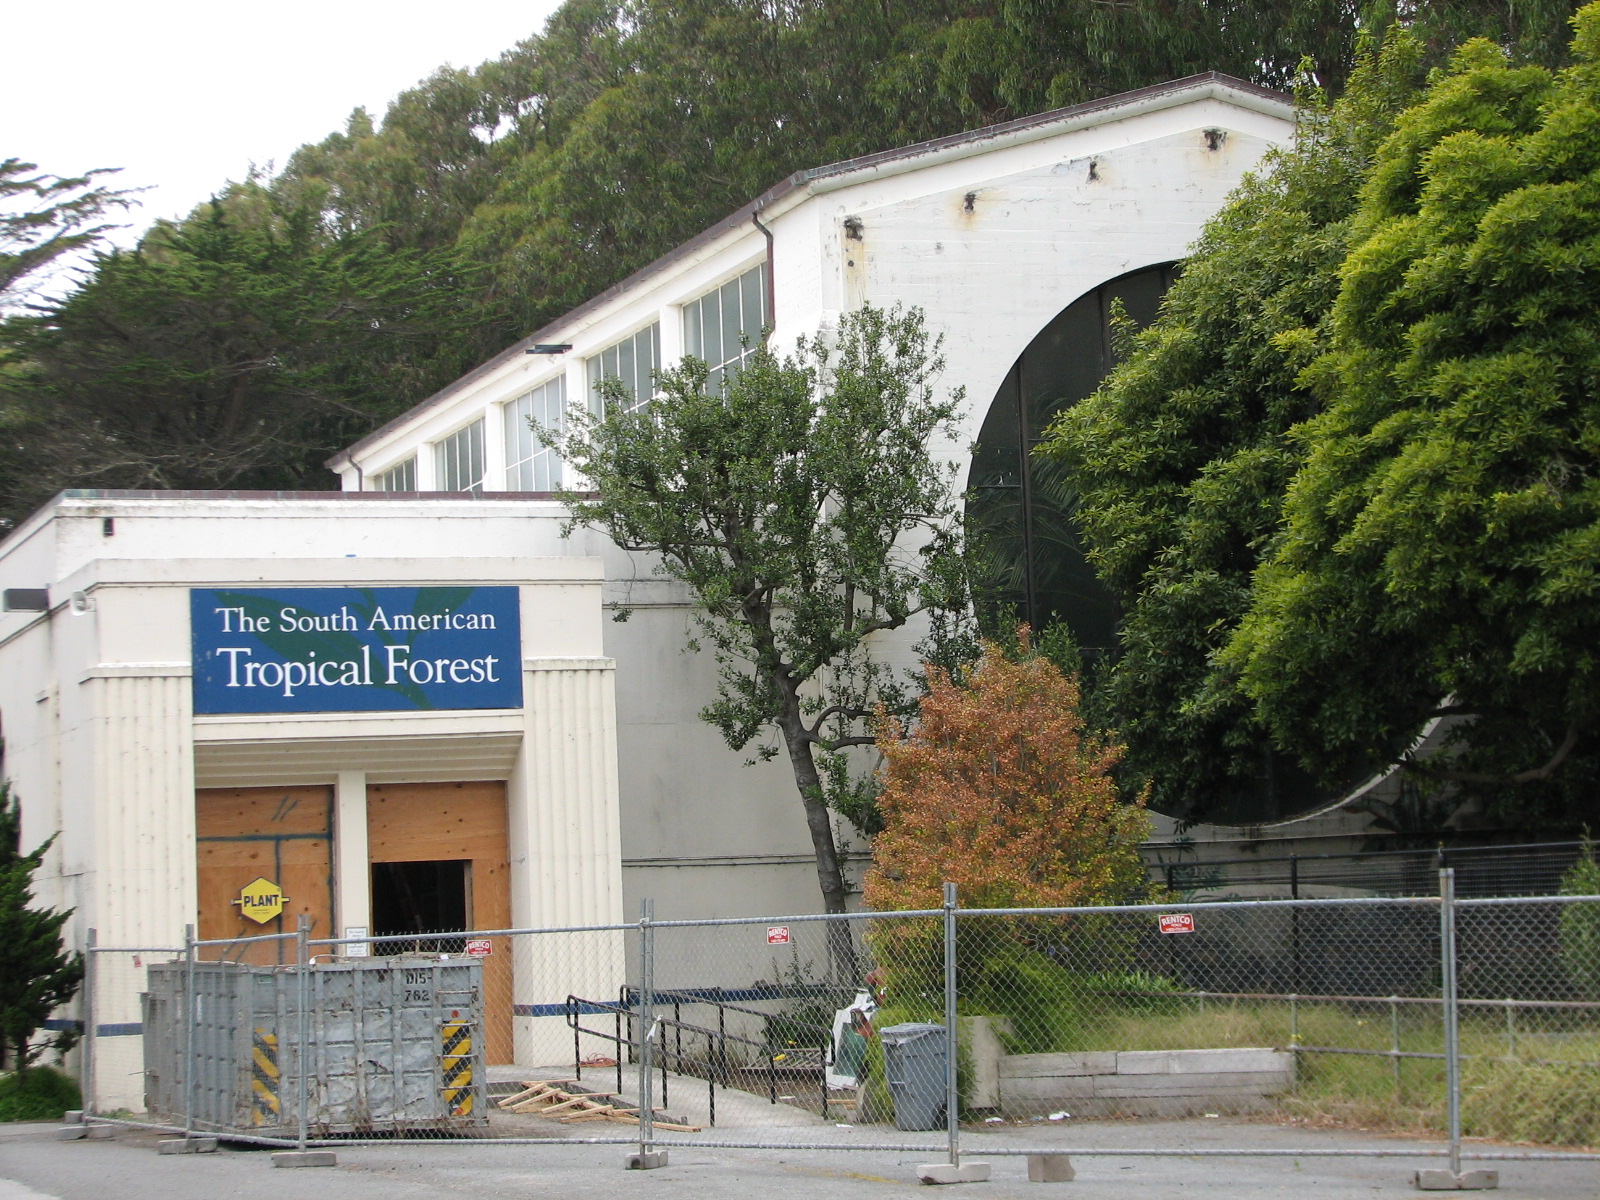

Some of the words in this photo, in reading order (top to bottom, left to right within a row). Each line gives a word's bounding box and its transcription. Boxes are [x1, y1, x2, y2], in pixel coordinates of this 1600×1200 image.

[215, 607, 270, 633] The
[280, 606, 358, 633] South
[367, 606, 496, 631] American
[216, 645, 374, 697] Tropical
[383, 645, 500, 686] Forest
[243, 894, 279, 907] PLANT
[1161, 915, 1190, 926] RENTCO
